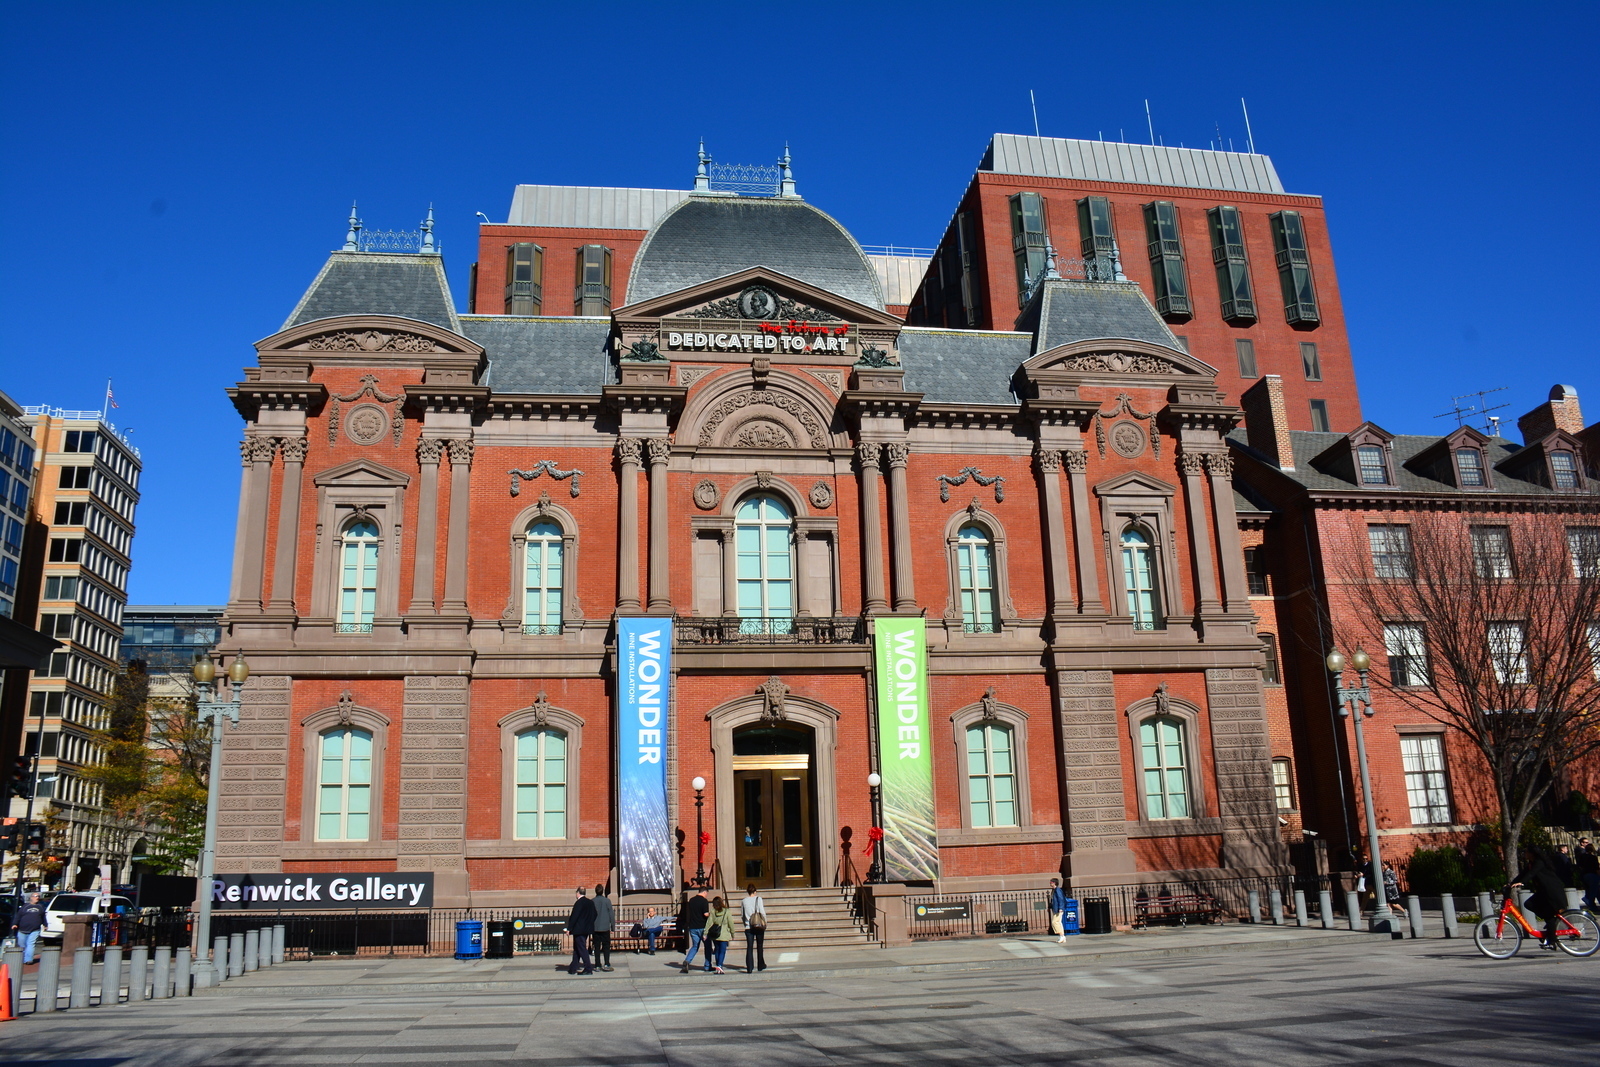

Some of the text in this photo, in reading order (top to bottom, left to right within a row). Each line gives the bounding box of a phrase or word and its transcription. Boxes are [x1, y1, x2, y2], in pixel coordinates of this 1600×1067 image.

[669, 332, 849, 351] DEDICATED TO ART
[757, 319, 849, 334] the future of
[638, 629, 661, 765] WONDER
[894, 629, 921, 761] WONDER
[211, 876, 425, 906] Renwick Gallery
